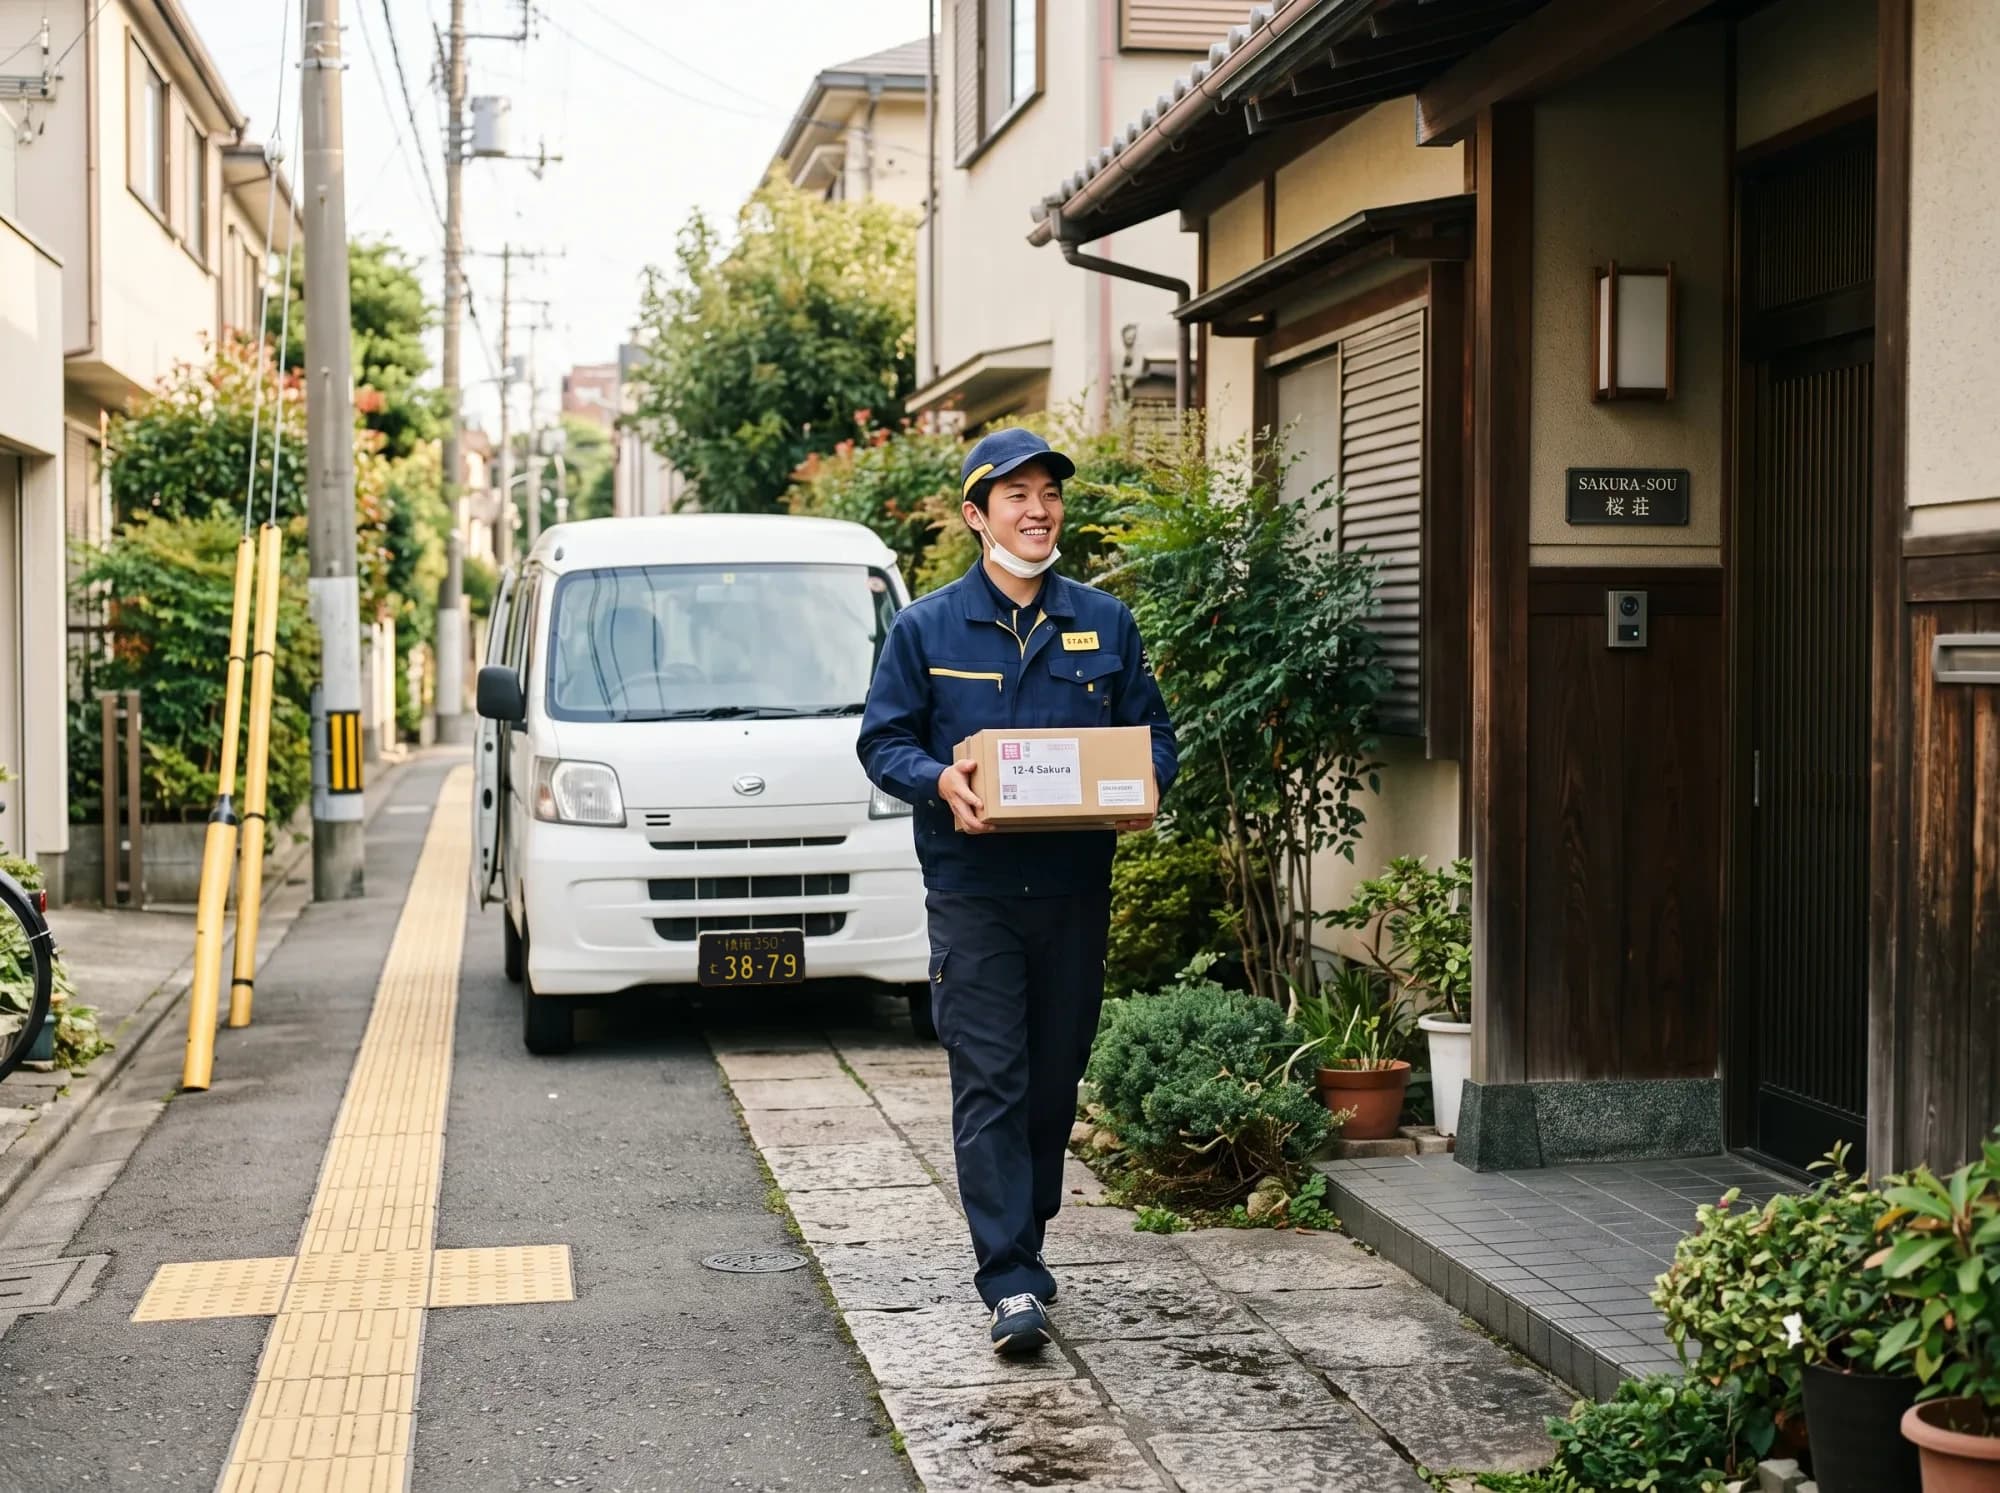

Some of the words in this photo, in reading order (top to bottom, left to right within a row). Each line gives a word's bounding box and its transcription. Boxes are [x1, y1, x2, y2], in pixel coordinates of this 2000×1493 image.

[1578, 477, 1677, 491] SAKURA-SOU
[1012, 765, 1034, 775] 12-4
[1036, 765, 1071, 774] Sakura
[724, 953, 797, 980] 38-79
